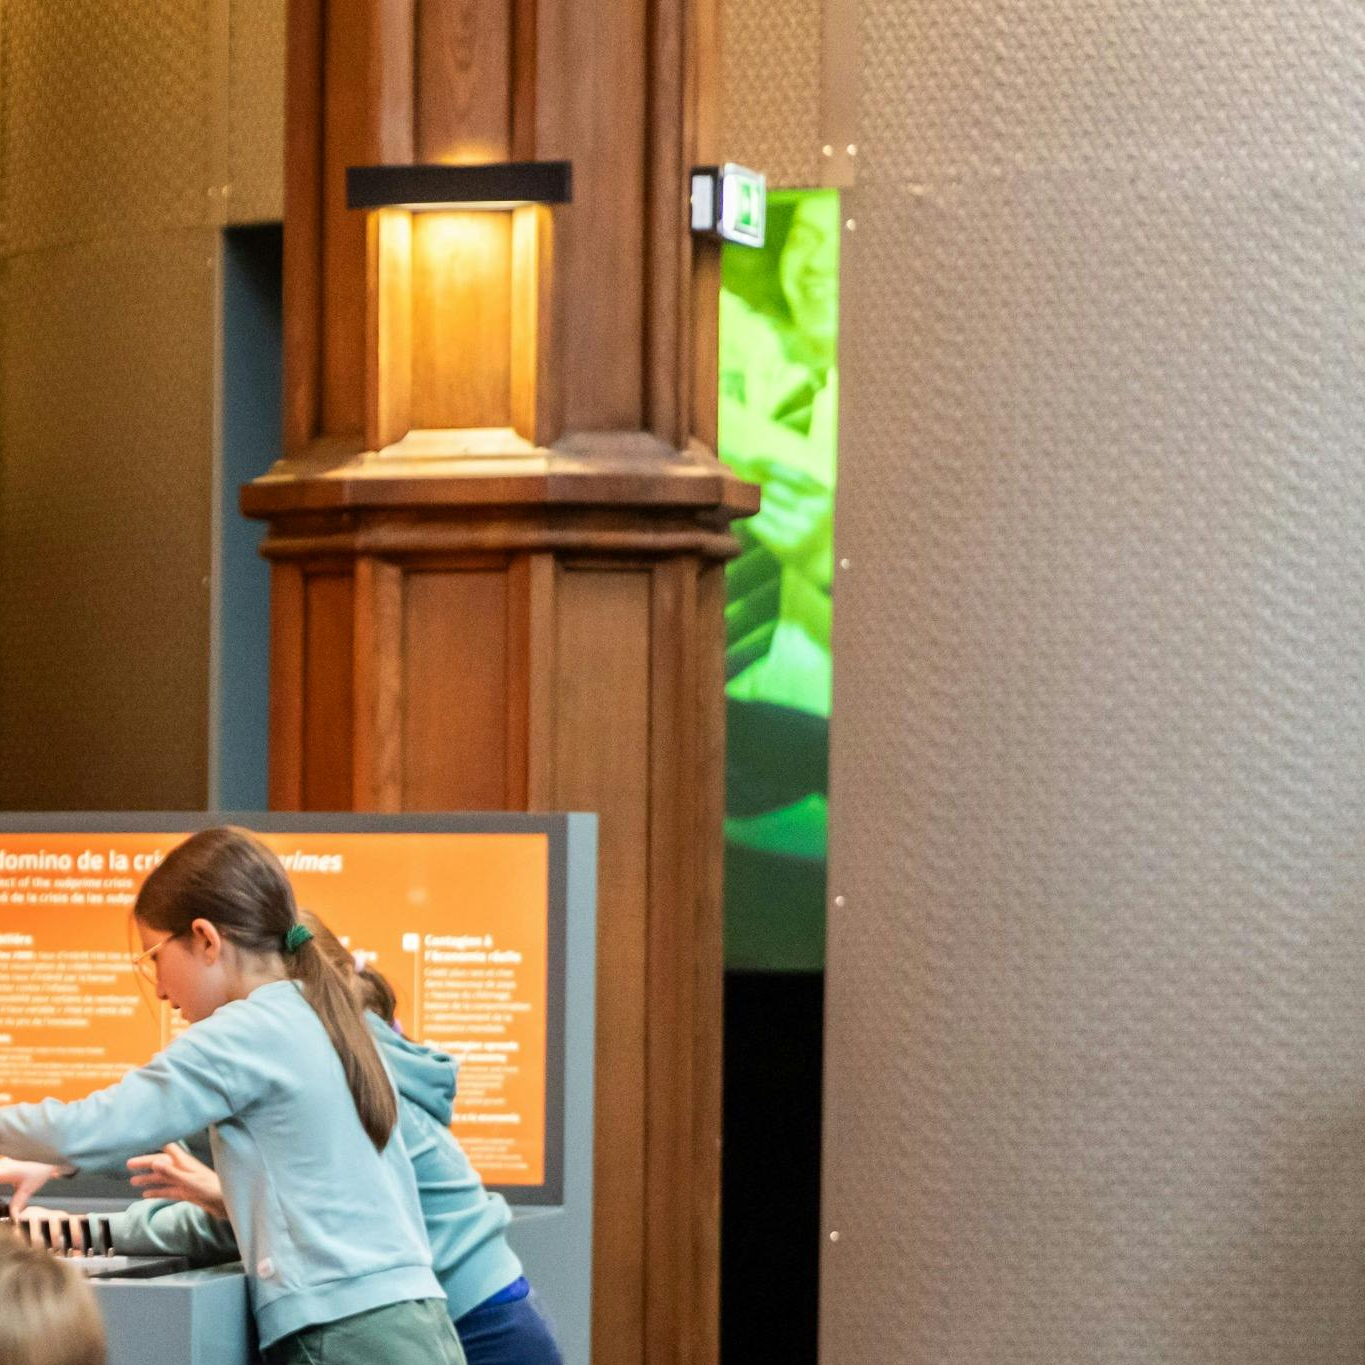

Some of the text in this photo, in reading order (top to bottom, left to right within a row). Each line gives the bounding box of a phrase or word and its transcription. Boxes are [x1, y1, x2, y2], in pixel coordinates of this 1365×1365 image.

[77, 849, 104, 871] de
[109, 849, 129, 871] la
[133, 849, 164, 871] cri
[279, 850, 342, 873] rimes
[18, 876, 30, 889] of
[32, 876, 51, 889] the
[103, 877, 134, 889] crisis
[10, 891, 24, 904] de
[27, 891, 37, 904] la
[70, 892, 85, 904] de
